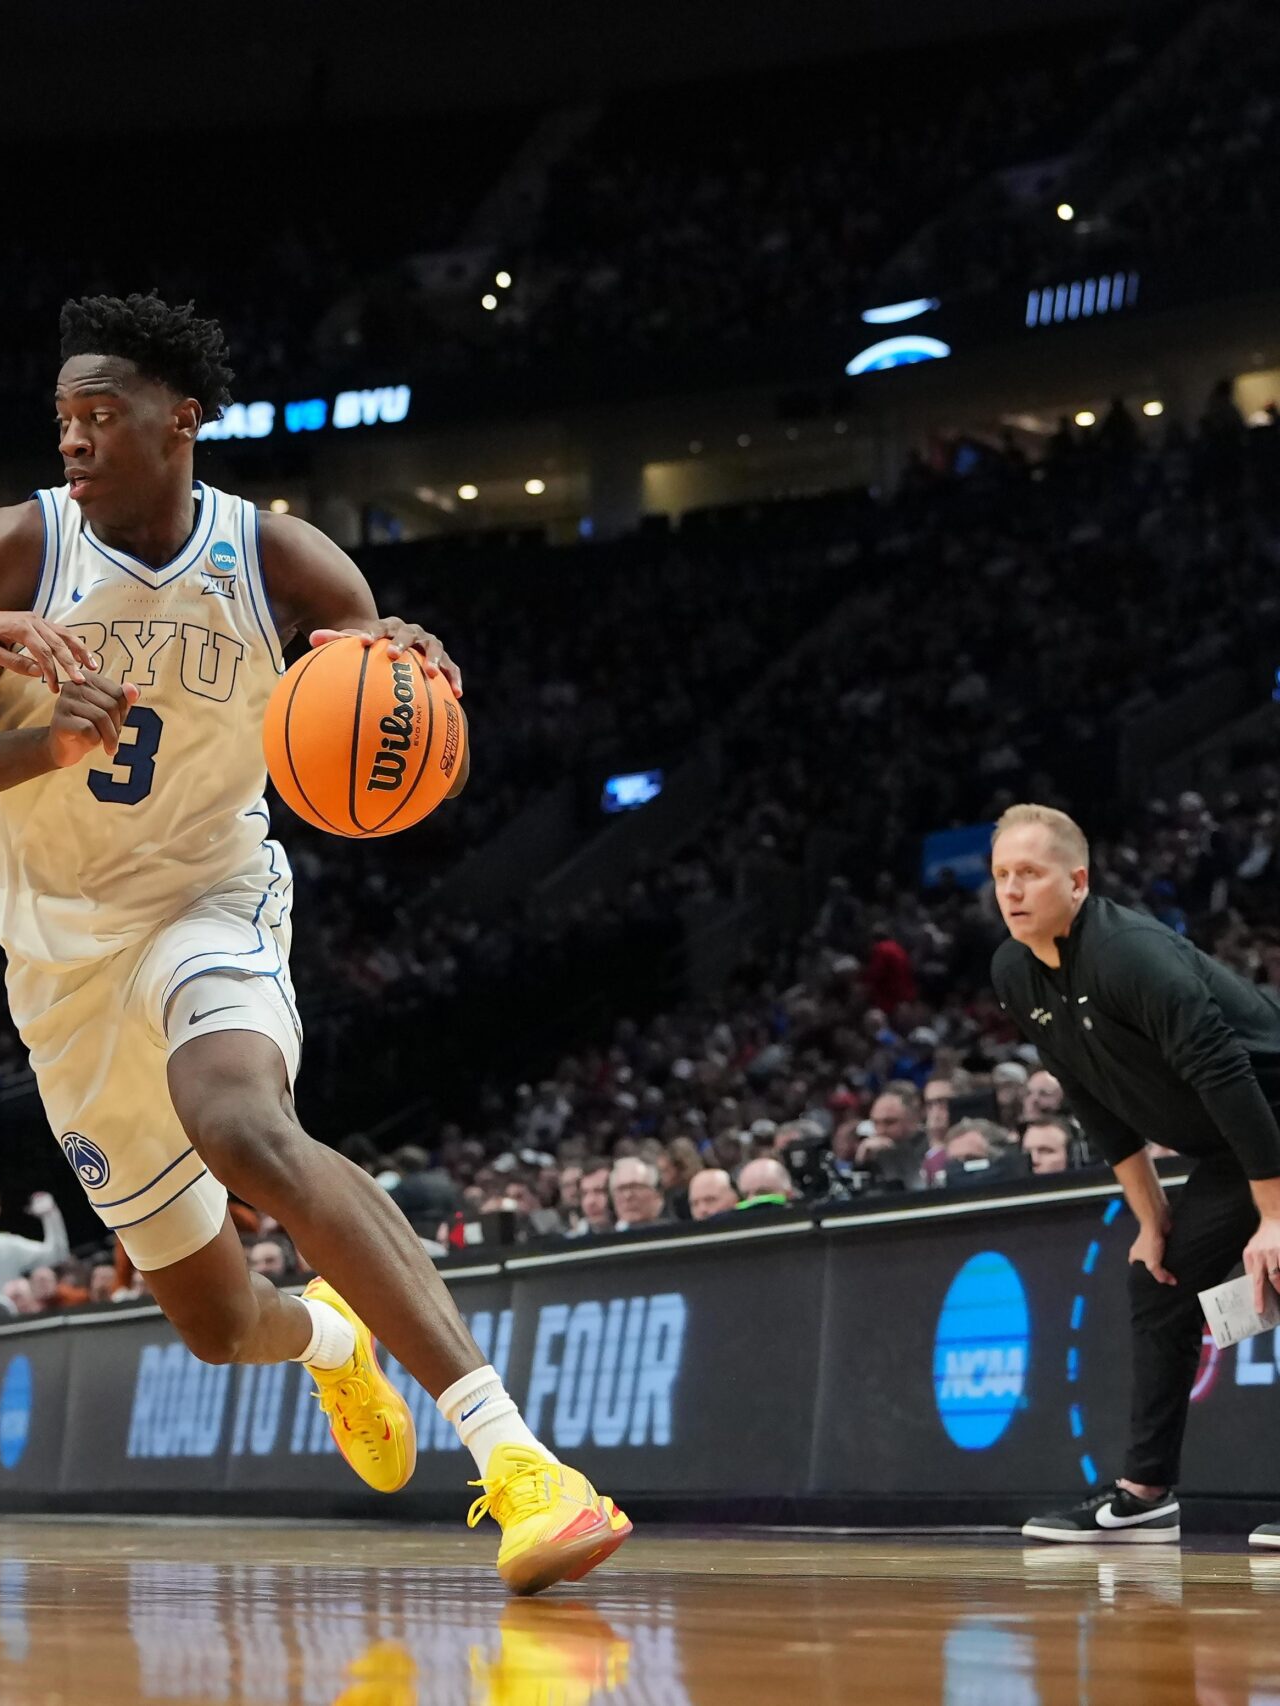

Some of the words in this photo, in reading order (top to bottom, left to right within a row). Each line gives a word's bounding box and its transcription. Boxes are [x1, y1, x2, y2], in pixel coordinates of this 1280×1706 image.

[332, 385, 411, 429] BYU
[215, 553, 236, 565] NCAA
[41, 620, 244, 703] BYU
[87, 706, 164, 806] 3
[366, 661, 416, 793] Wilson
[126, 1343, 231, 1458] ROAD
[522, 1292, 688, 1449] FOUR
[940, 1347, 1024, 1399] NCAA
